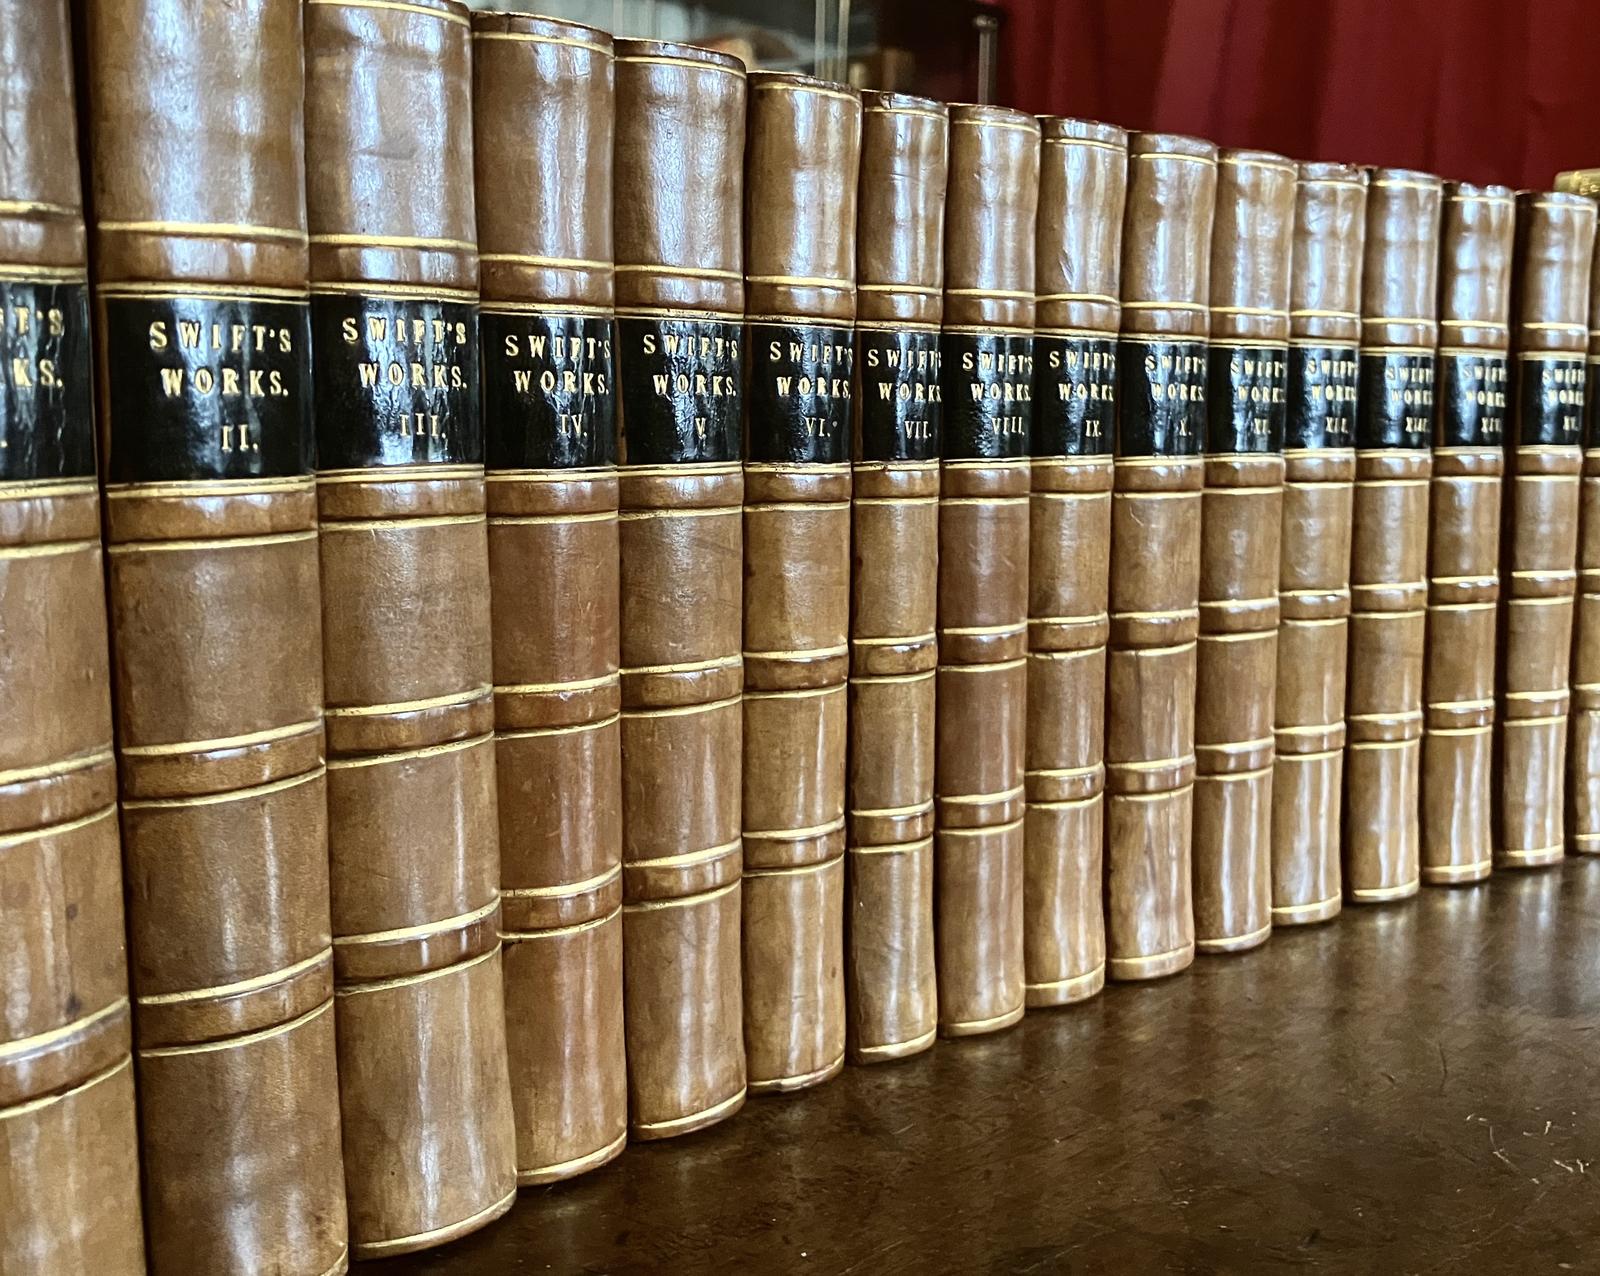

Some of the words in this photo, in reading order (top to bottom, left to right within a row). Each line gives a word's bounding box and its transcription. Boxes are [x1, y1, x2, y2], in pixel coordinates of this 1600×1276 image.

[150, 321, 292, 352] SWIFT'S
[342, 317, 466, 345] SWIFT'S
[505, 335, 611, 360] SWIFT'S
[643, 334, 737, 359] SWIFT'S
[160, 368, 289, 398] WORKS.
[359, 362, 467, 389] WORKS.
[514, 370, 609, 395] WORKS.
[653, 374, 736, 397] WORKS.
[776, 376, 851, 399] WORKS.
[221, 424, 259, 451] II.
[400, 412, 447, 438] III.
[560, 414, 587, 437] IV.
[695, 418, 706, 439] V.
[805, 418, 830, 437] VI.
[904, 421, 932, 439] VII.
[991, 417, 1025, 436] VIII.
[1085, 420, 1102, 437] IX.
